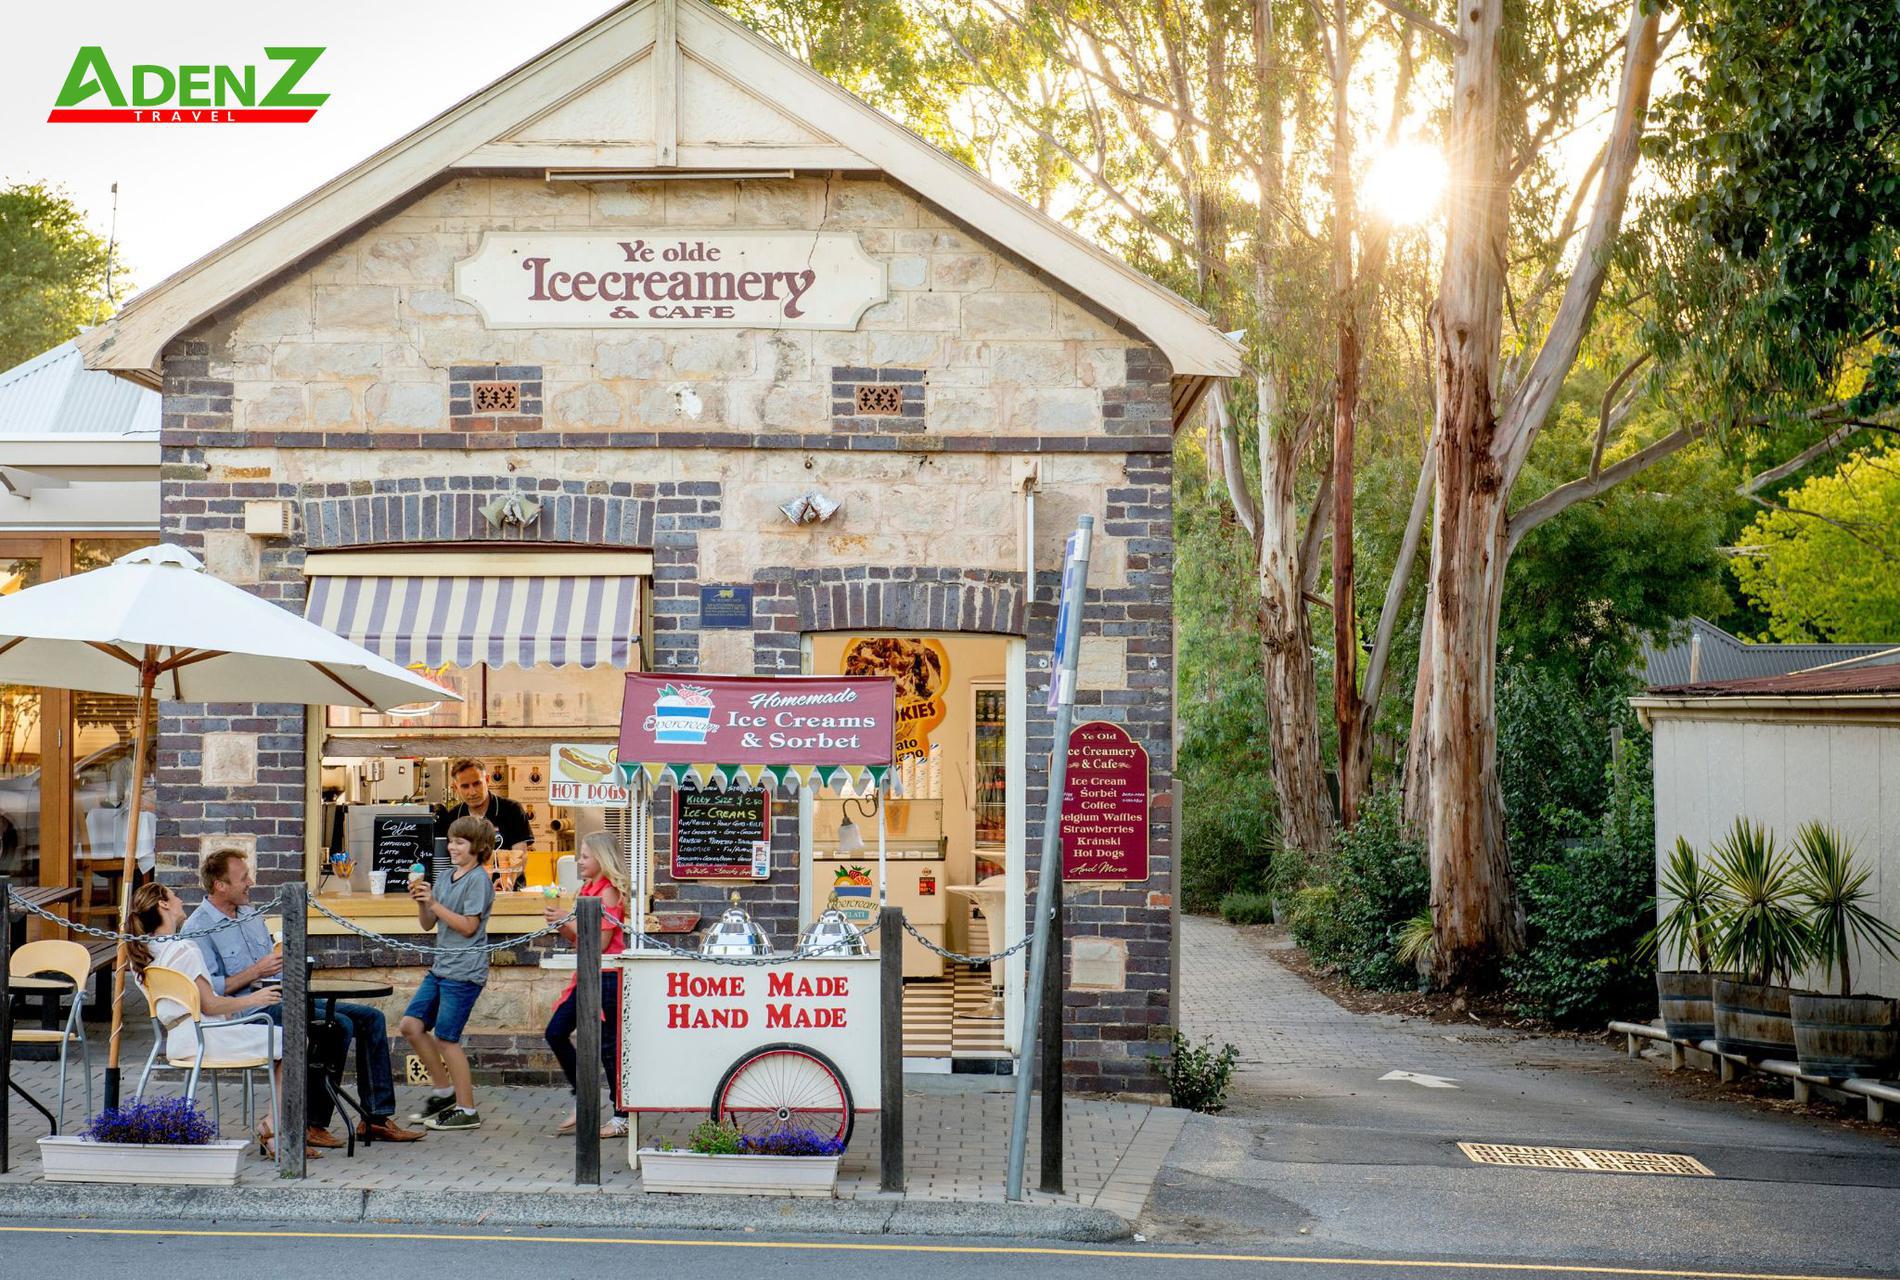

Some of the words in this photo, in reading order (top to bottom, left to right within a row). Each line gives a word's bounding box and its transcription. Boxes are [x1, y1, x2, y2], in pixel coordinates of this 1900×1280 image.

[617, 239, 655, 263] Ye
[662, 241, 721, 262] olde
[522, 256, 816, 319] Icecreamery
[608, 305, 640, 319] &
[648, 305, 735, 319] CAFE
[747, 687, 857, 710] Homemade
[726, 711, 767, 728] Ice
[774, 711, 876, 728] Creams
[740, 731, 763, 749] &
[768, 731, 861, 749] Sorbet
[896, 739, 918, 751] ato
[1067, 748, 1080, 756] ce
[1082, 745, 1137, 758] Creamery
[1081, 759, 1091, 769] &
[1093, 758, 1118, 769] Cafe
[1071, 777, 1088, 786] Ice
[1090, 777, 1127, 786] Cream
[551, 783, 582, 799] HOT
[587, 784, 627, 800] DOGS
[1080, 788, 1117, 798] Sorbet
[1081, 801, 1117, 810] Coffee
[1103, 813, 1143, 822] Waffles
[382, 820, 417, 836] Coffee
[1063, 825, 1135, 834] Strawberries
[1073, 849, 1093, 857] Hot
[1096, 849, 1125, 860] Dogs
[1069, 862, 1098, 875] And
[1099, 861, 1128, 874] More
[666, 972, 746, 998] HOME
[767, 972, 849, 998] MADE
[667, 1003, 749, 1029] HAND
[765, 1003, 848, 1029] MADE
